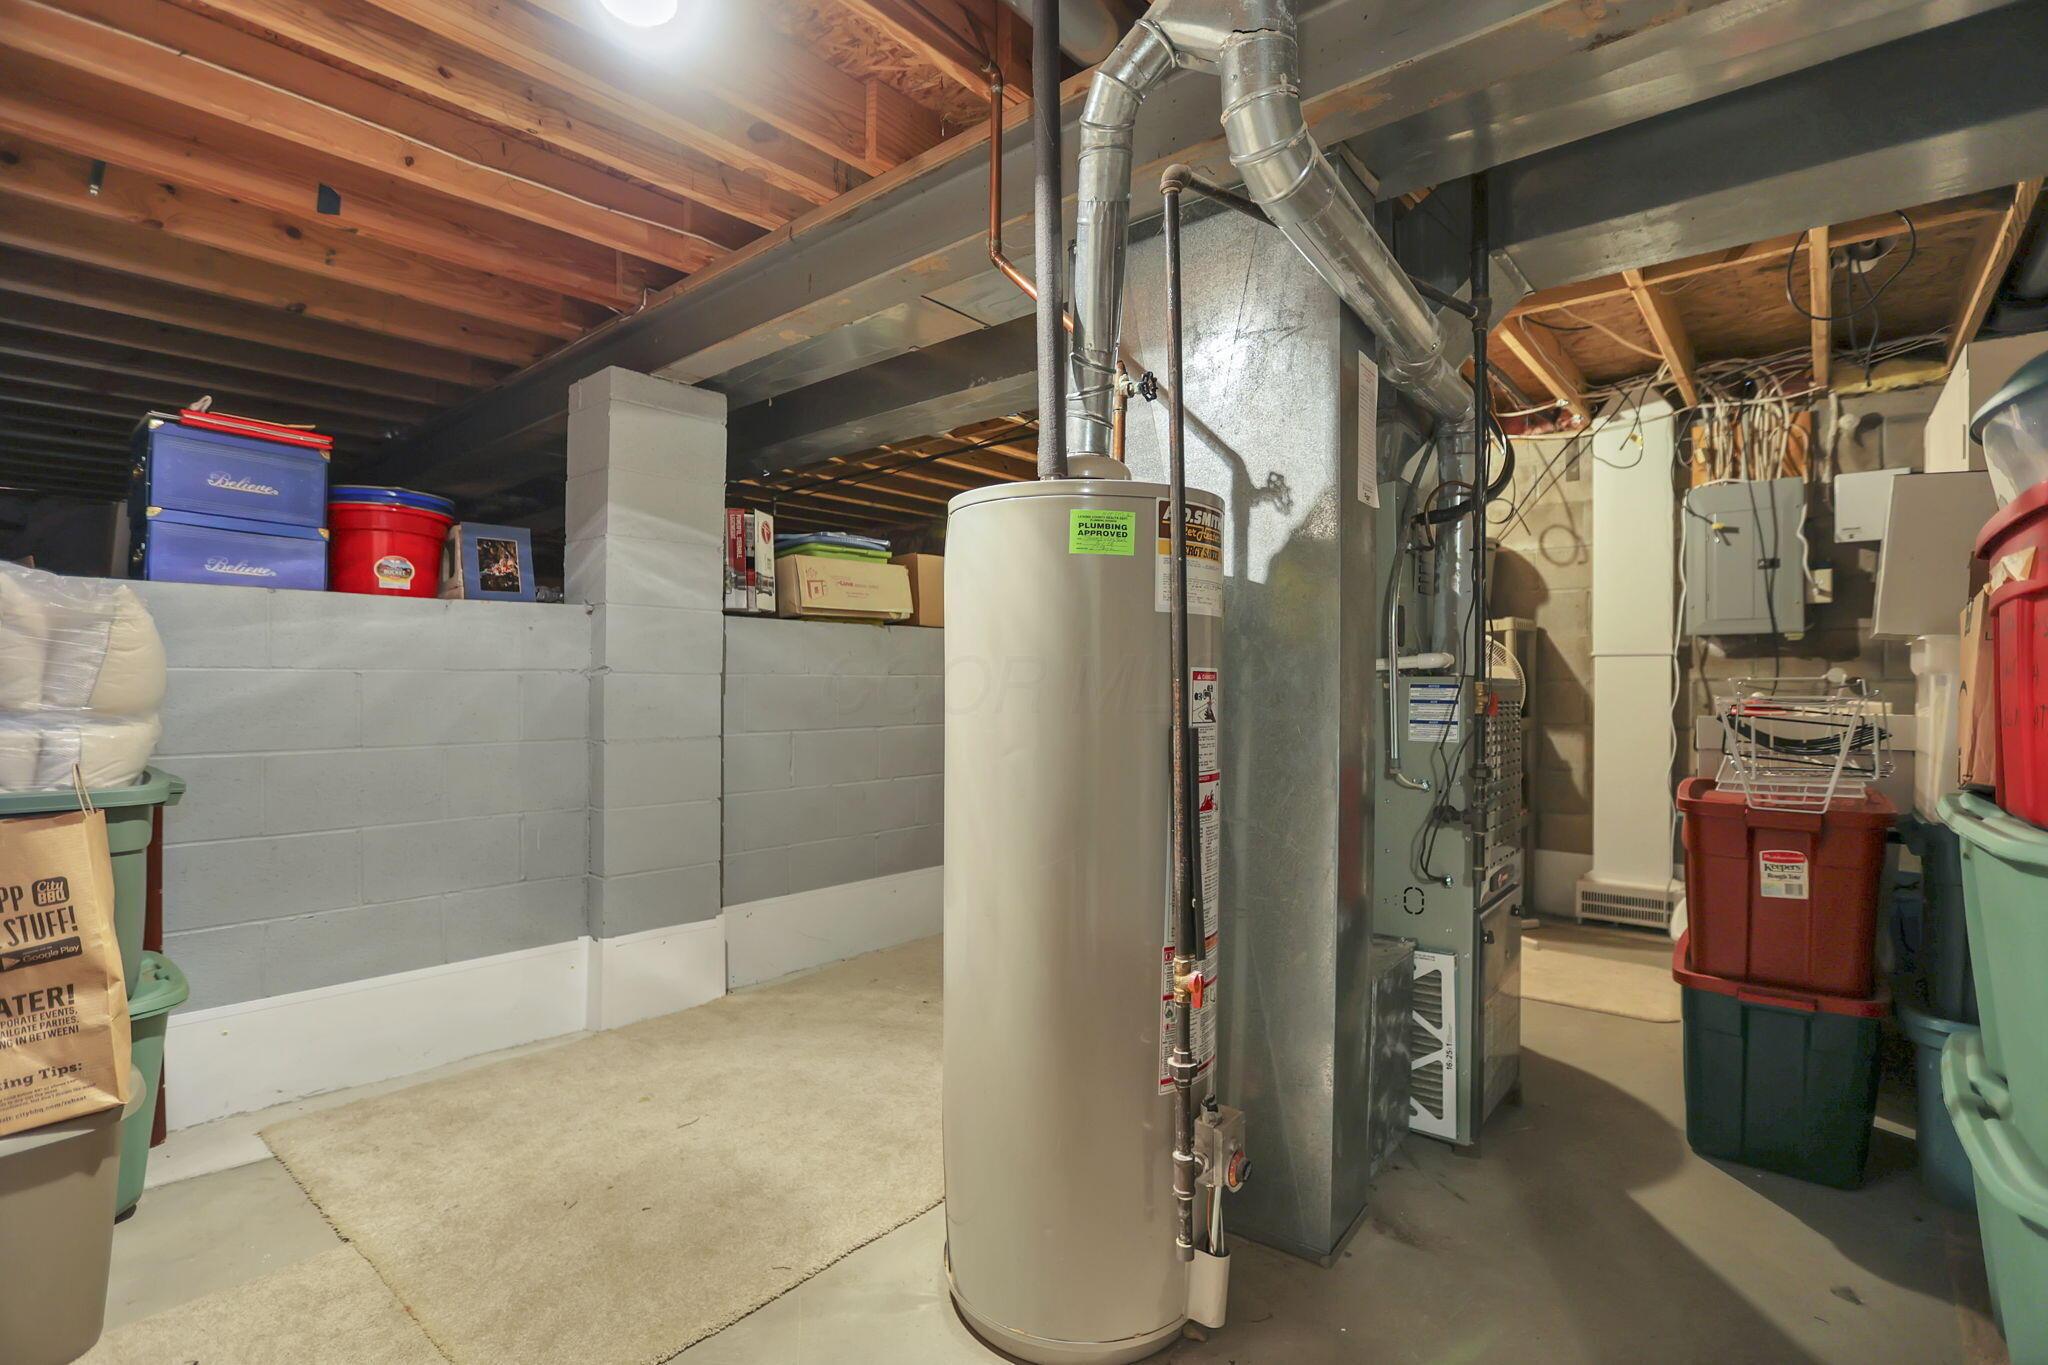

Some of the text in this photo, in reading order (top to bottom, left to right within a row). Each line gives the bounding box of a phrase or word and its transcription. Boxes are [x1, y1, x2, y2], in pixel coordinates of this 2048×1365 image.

[207, 470, 279, 496] Believe
[1077, 530, 1128, 538] APPROVED
[1078, 522, 1128, 531] PLUMBING
[204, 555, 277, 577] Believe
[1764, 863, 1801, 872] Keepers
[37, 880, 64, 893] City
[3, 905, 79, 947] STUFF!
[22, 949, 59, 963] Google
[60, 944, 80, 955] Play
[38, 1062, 82, 1080] Tips:
